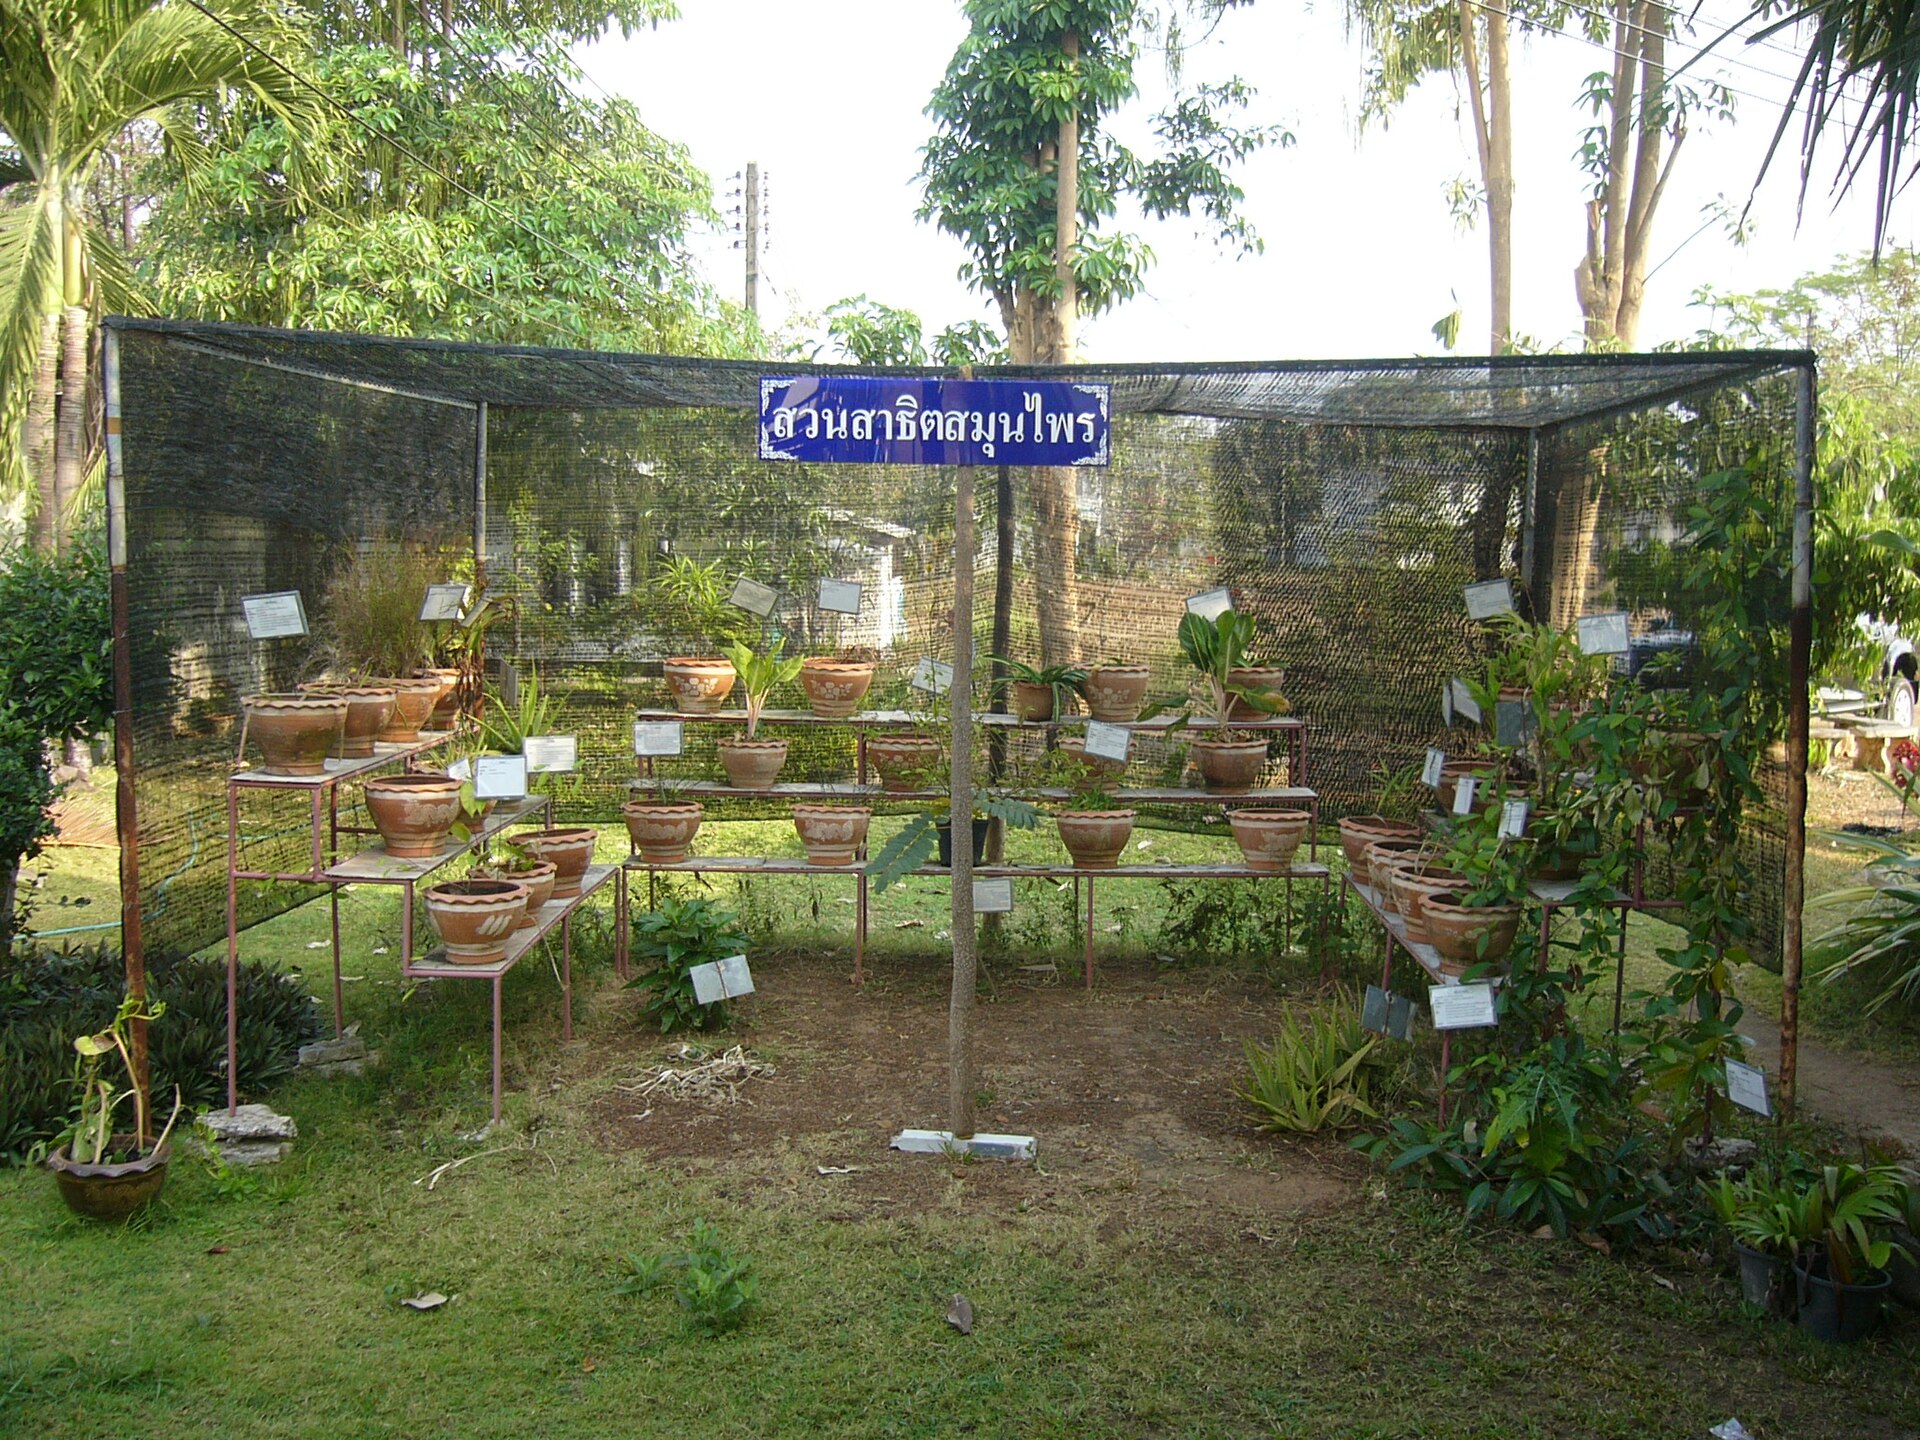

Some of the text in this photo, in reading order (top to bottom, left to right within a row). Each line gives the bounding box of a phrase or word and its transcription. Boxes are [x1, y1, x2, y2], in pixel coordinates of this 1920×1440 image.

[773, 391, 1096, 458] สวนสาธิตสมุนไพร
